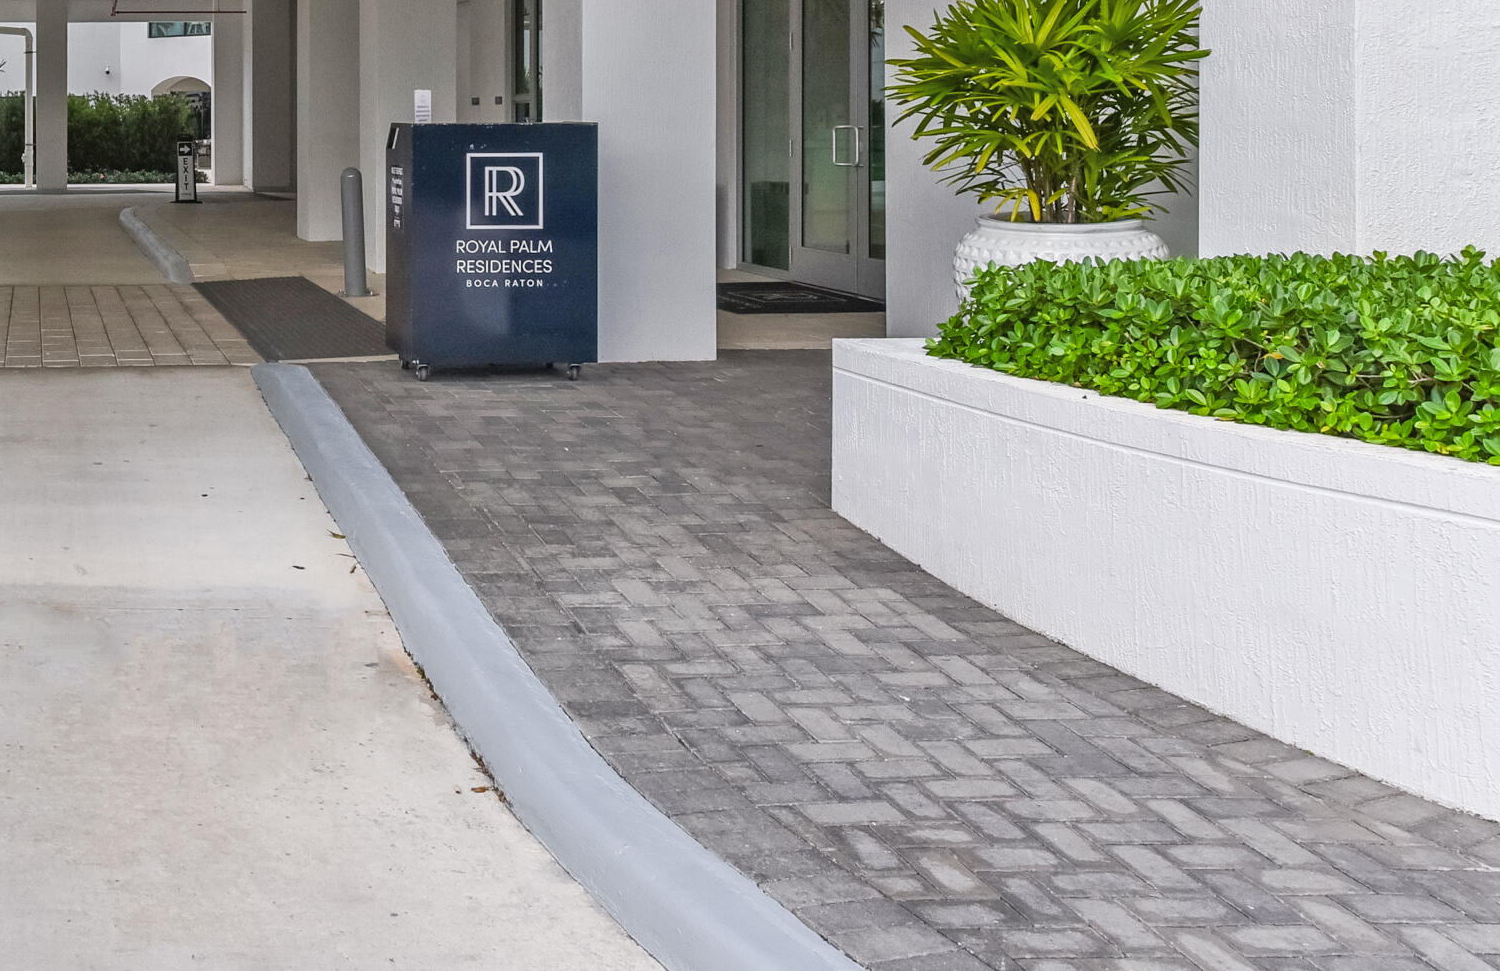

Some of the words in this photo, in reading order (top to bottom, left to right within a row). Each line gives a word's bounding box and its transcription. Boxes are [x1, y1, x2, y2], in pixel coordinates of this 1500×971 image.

[456, 239, 506, 254] ROYAL
[510, 239, 553, 254] PALM
[456, 259, 553, 273] RESIDENCES
[466, 279, 499, 287] BOCA
[504, 279, 543, 287] RATON
